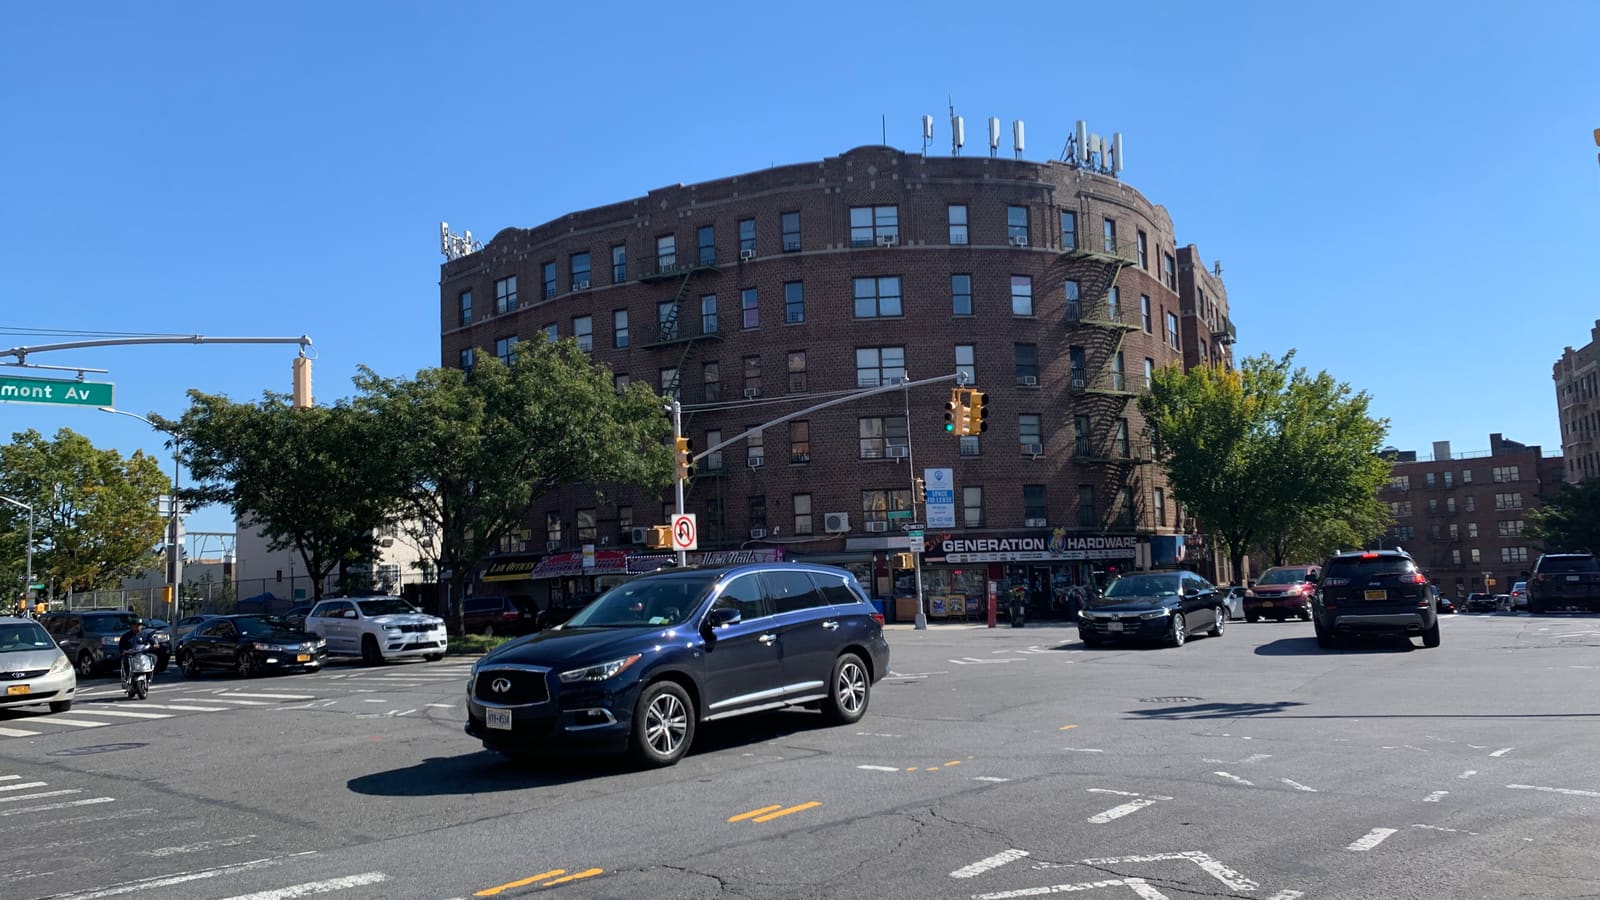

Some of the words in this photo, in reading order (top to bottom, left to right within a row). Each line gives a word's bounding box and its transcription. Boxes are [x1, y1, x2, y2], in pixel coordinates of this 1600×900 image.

[65, 387, 90, 400] Av
[942, 538, 1044, 553] GENERATION
[1067, 537, 1136, 550] HARDWARE
